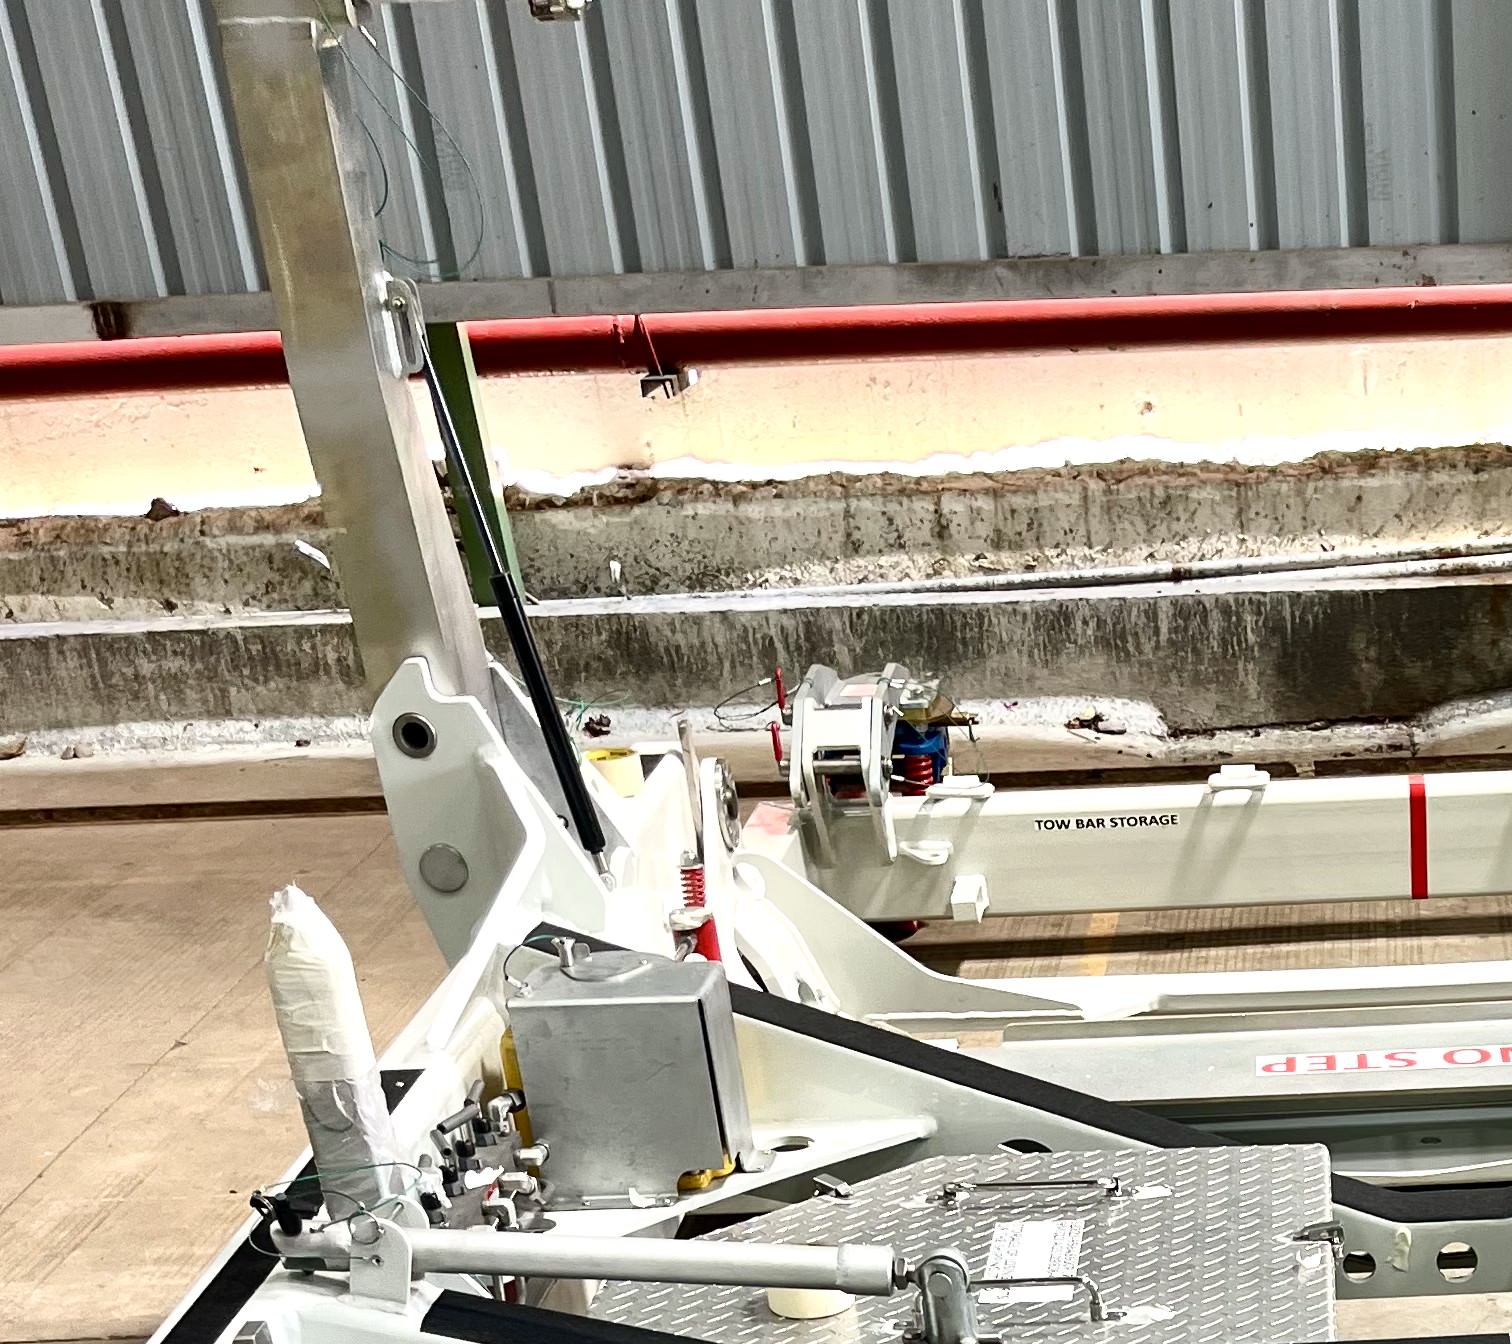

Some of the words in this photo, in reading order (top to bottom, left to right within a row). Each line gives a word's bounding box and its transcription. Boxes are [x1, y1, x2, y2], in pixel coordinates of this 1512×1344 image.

[1035, 819, 1070, 830] TOW
[1076, 818, 1105, 829] BAR
[1110, 814, 1179, 828] STORAGE
[1261, 1051, 1419, 1073] STEP
